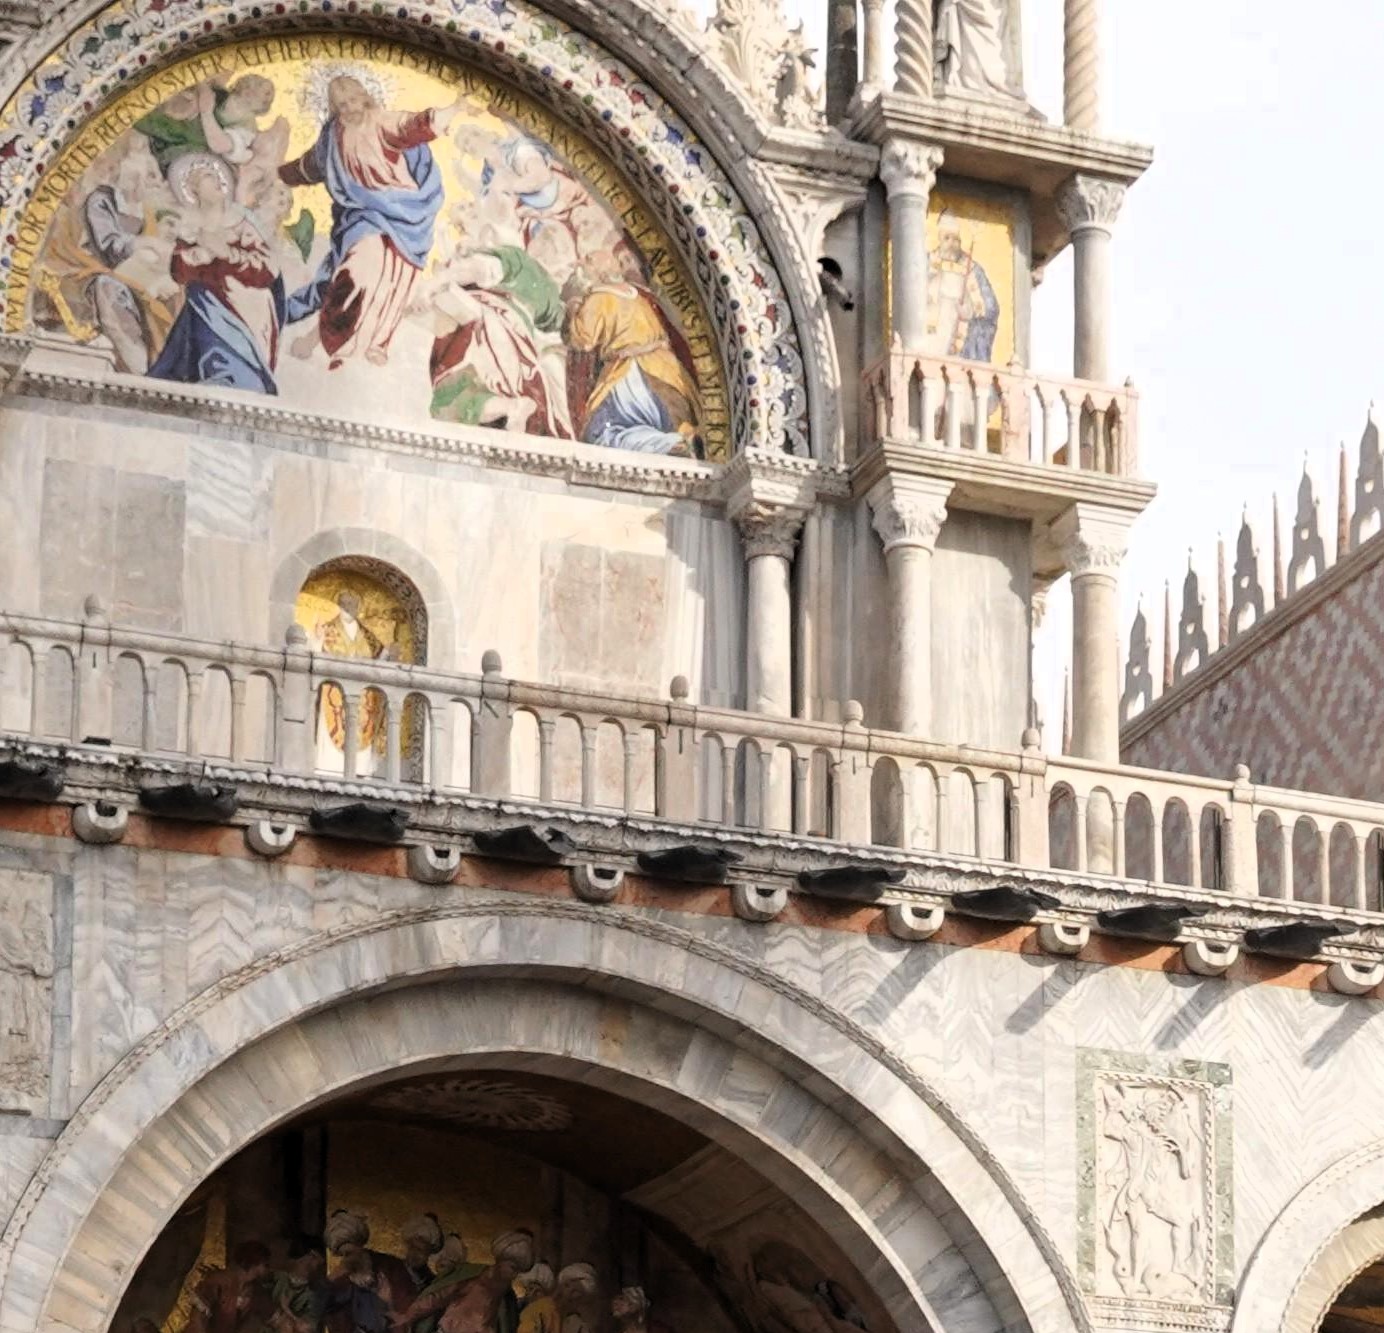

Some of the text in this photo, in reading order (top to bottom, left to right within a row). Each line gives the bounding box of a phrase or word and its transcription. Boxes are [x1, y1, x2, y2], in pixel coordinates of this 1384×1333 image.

[7, 211, 47, 290] VICTOR
[36, 137, 101, 212] MORTIS
[94, 86, 162, 147] REGNO
